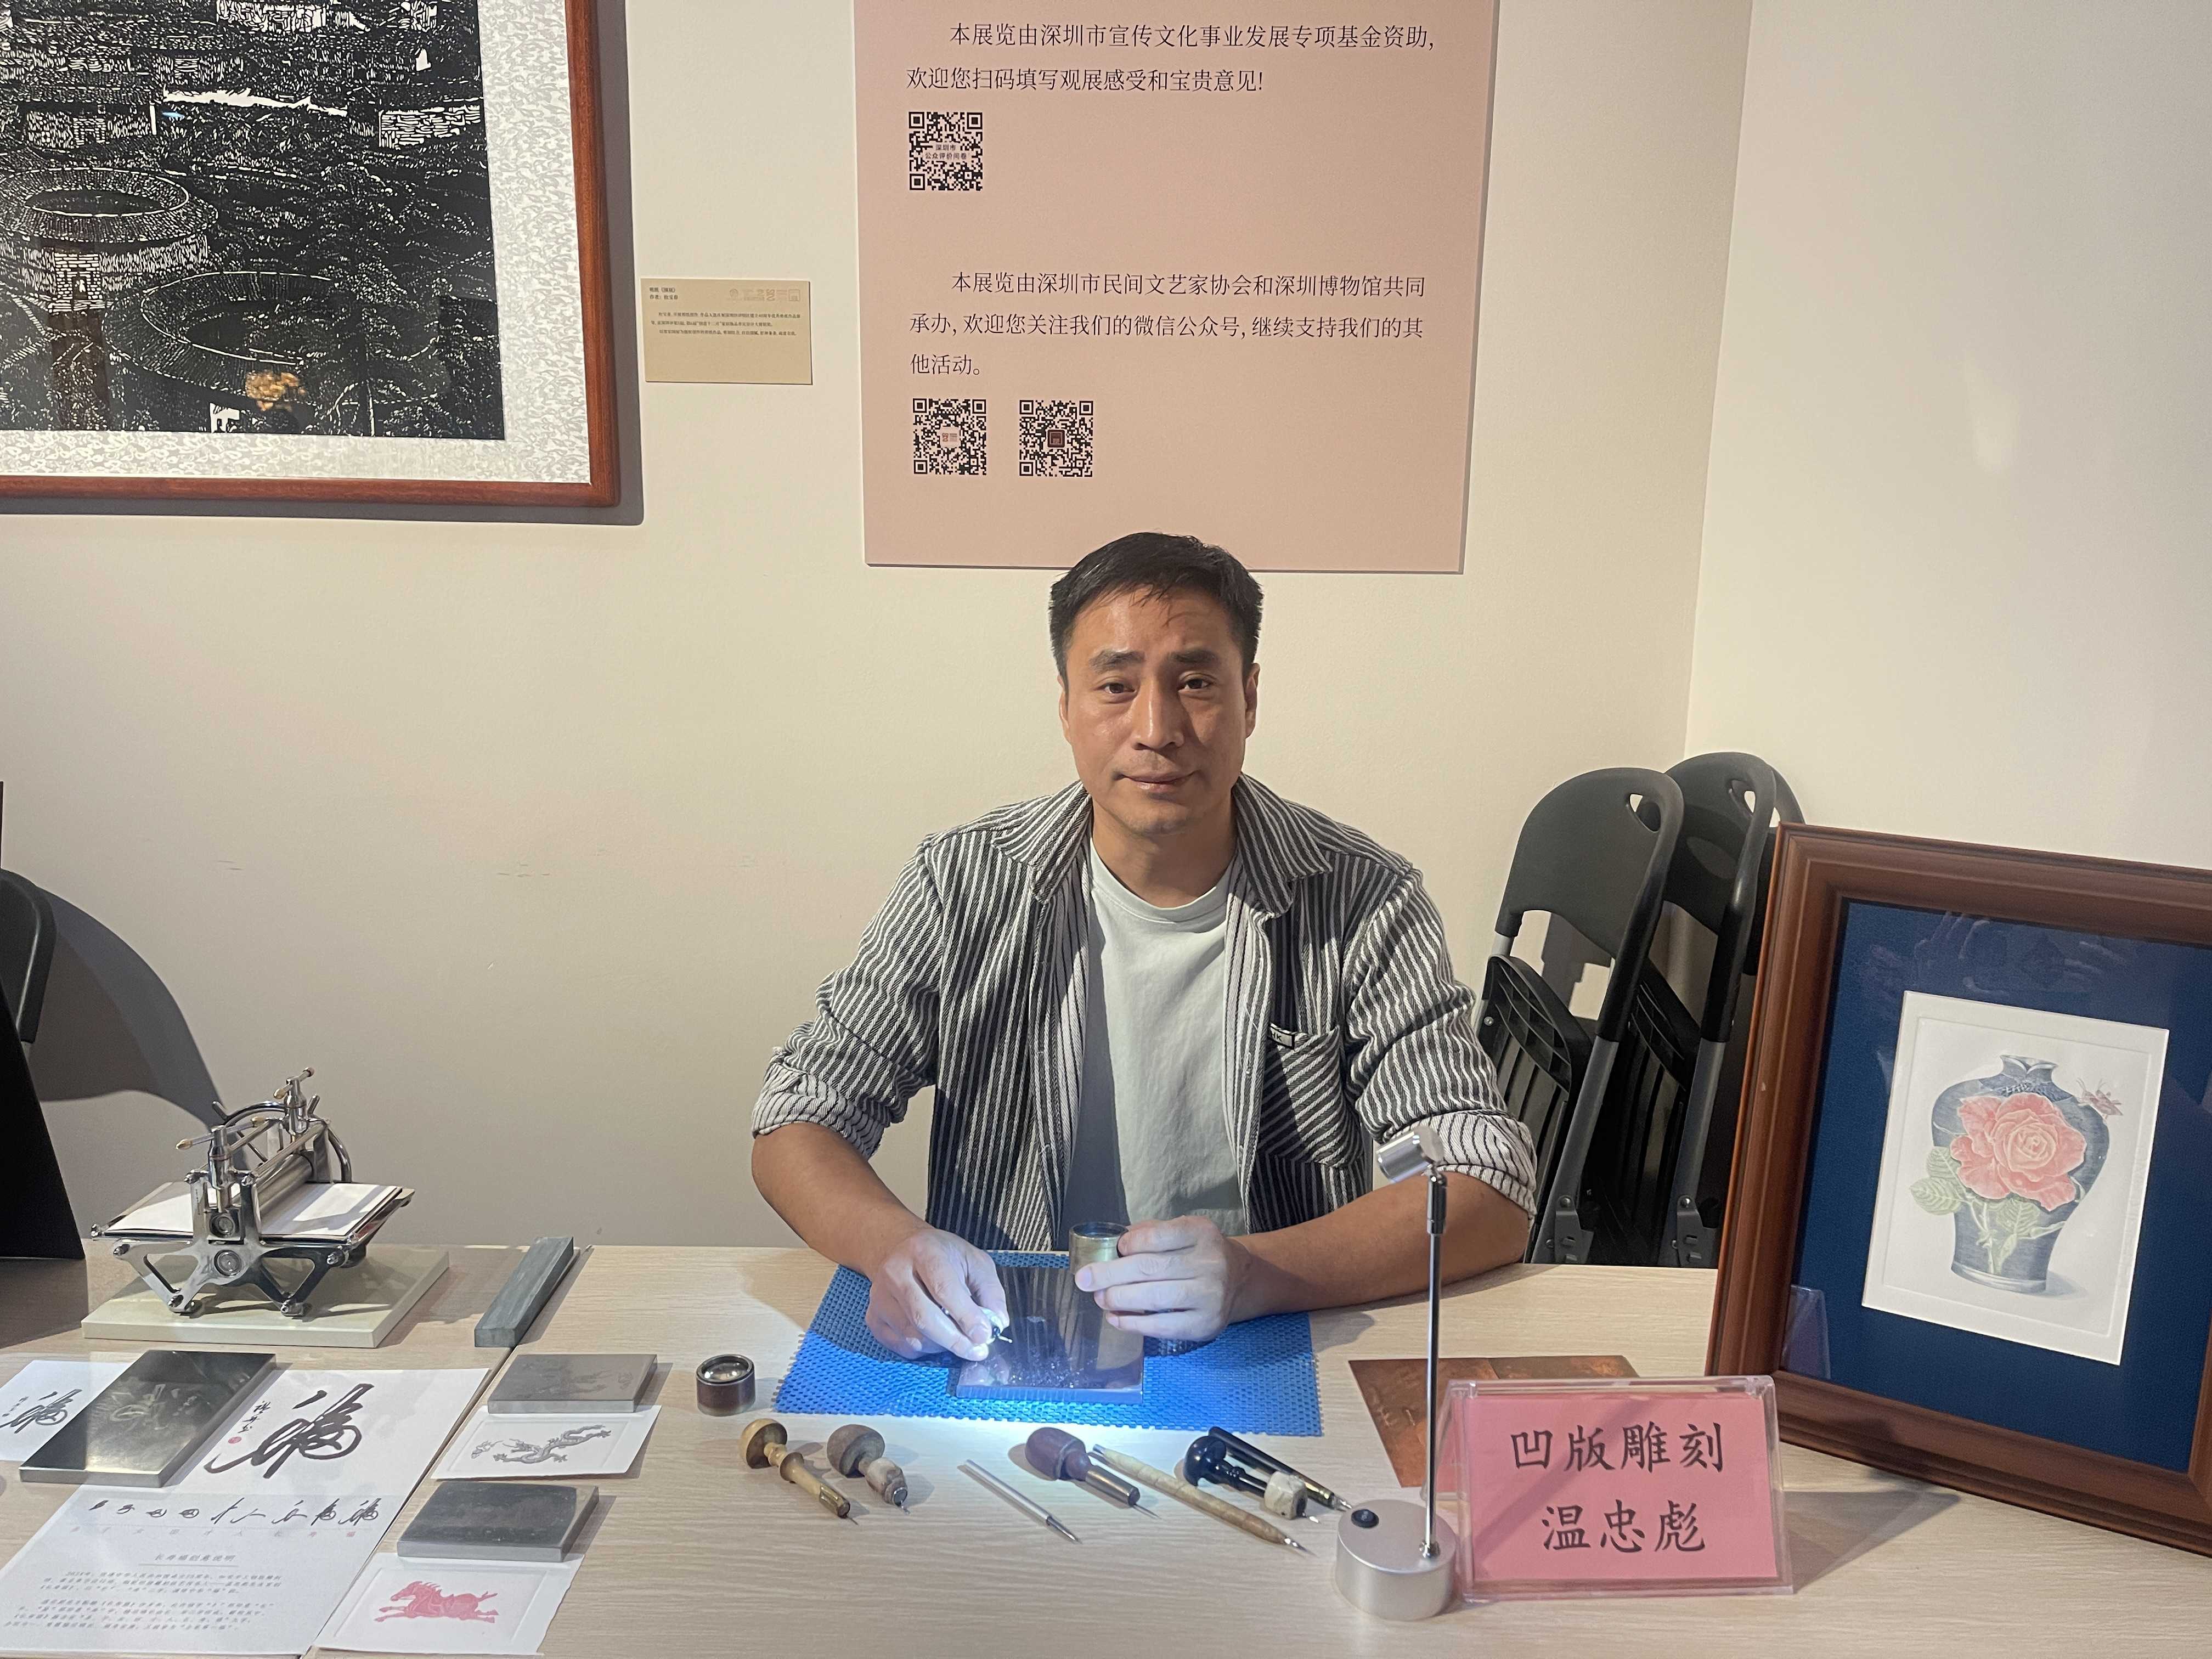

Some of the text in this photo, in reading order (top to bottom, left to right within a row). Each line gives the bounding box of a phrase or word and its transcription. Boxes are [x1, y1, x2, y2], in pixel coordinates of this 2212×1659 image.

[949, 22, 1434, 52] 本展览由深圳市宣传文化事业发展专项基金资助，
[906, 66, 1263, 92] 欢迎您扫码填写观展感受和宝贵意见！
[951, 271, 1425, 298] 本展览由深圳市民间文艺家协会和深圳博物馆共同
[909, 312, 1424, 340] 承办，欢迎您关注我们的微信公众号，继续支持我们的其
[910, 353, 980, 375] 他活动。
[1510, 1420, 1723, 1473] 凹版雕刻
[1541, 1499, 1706, 1553] 温忠彪
